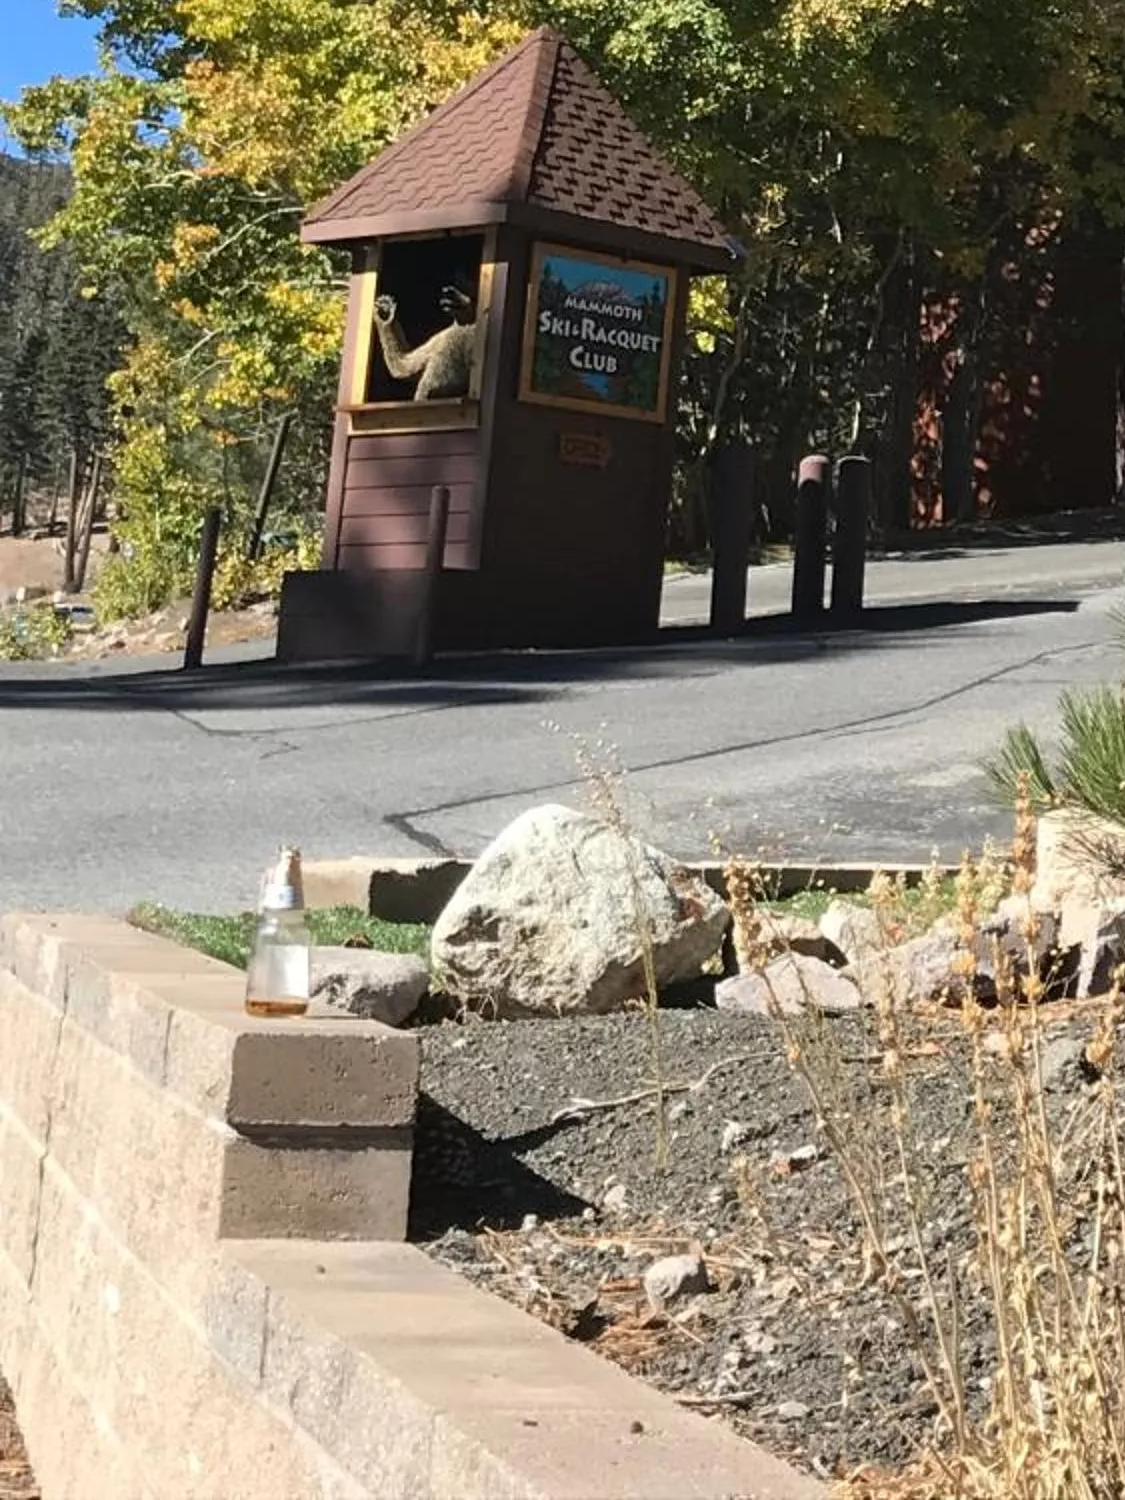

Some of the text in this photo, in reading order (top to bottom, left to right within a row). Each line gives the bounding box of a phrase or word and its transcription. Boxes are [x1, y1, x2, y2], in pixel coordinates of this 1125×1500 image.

[565, 296, 643, 321] MAMMOTH
[581, 318, 661, 353] RACQUET
[569, 346, 617, 373] CLUB
